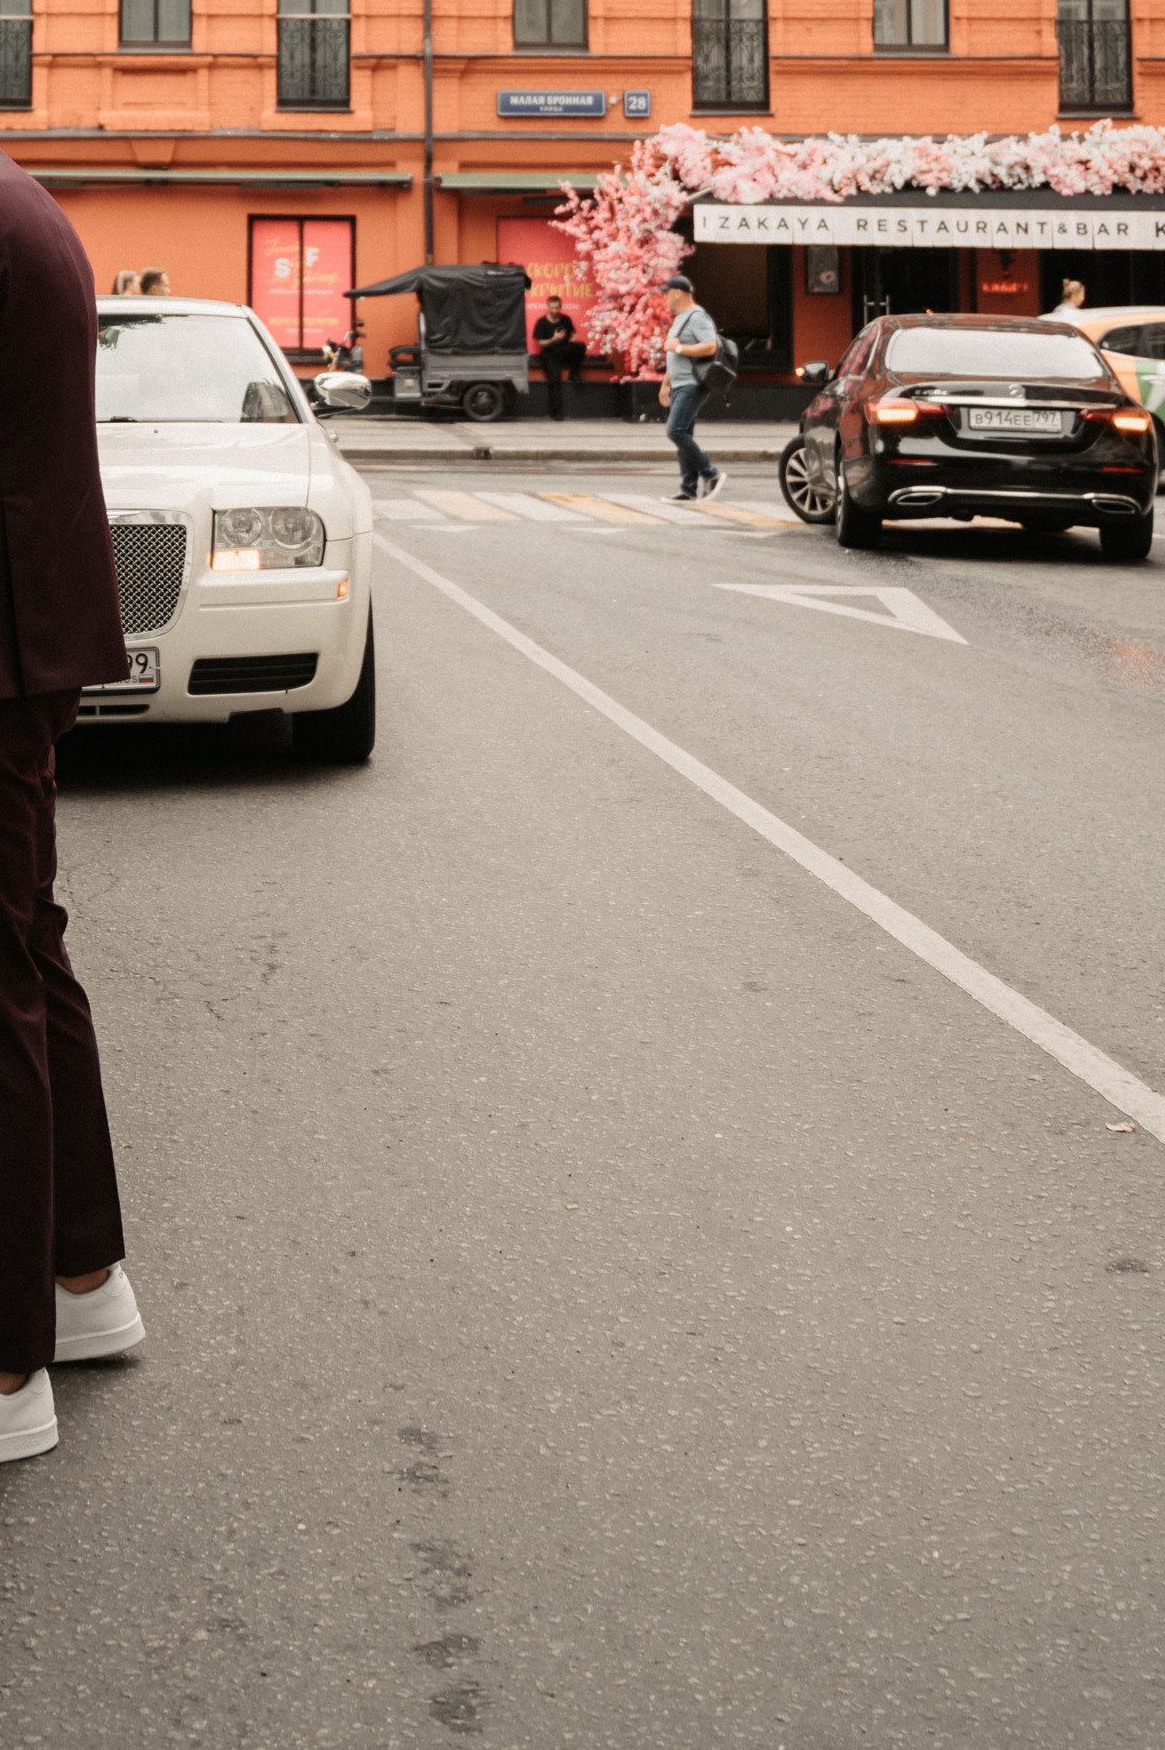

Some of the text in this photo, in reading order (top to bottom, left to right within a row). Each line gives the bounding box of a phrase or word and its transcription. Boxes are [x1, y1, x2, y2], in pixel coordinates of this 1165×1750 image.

[510, 95, 594, 106] МАЛАЯ БРОННАЯ
[628, 96, 646, 110] 28
[702, 216, 829, 231] IZAKAYA
[525, 282, 594, 298] КРЫТИЕ
